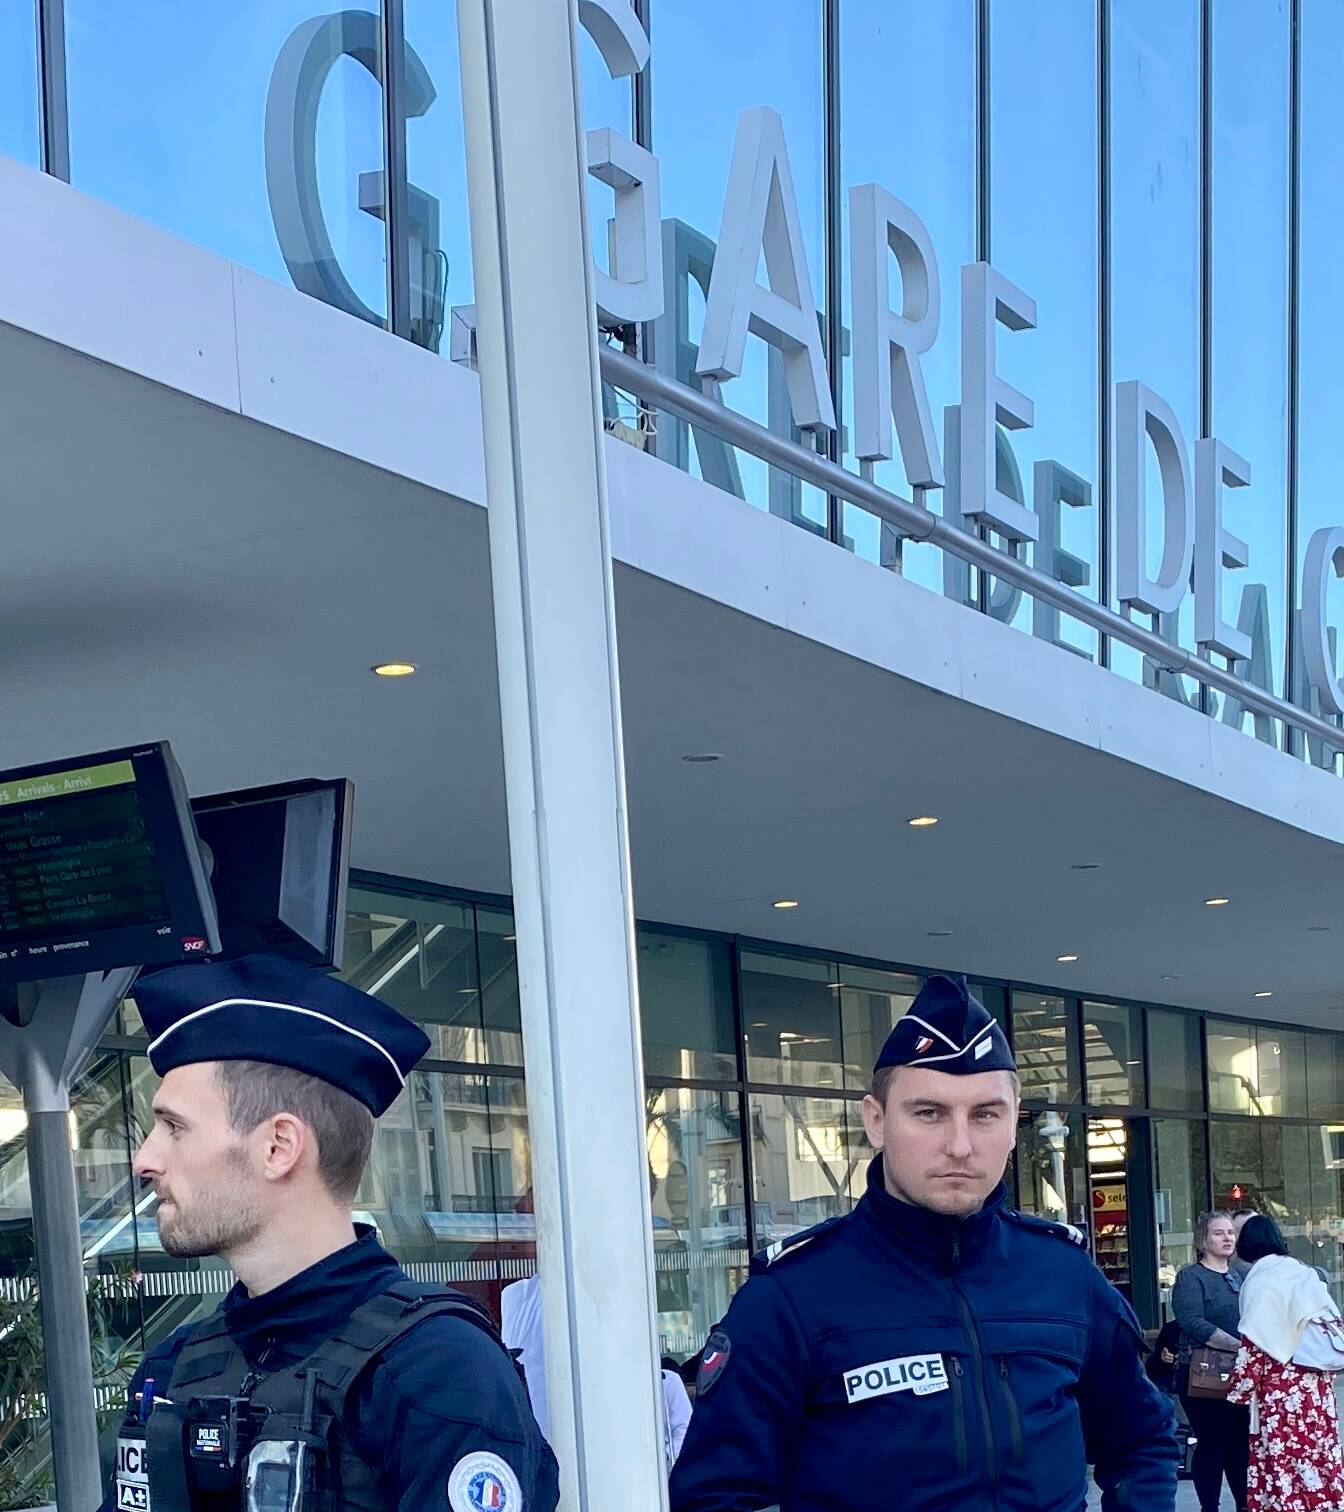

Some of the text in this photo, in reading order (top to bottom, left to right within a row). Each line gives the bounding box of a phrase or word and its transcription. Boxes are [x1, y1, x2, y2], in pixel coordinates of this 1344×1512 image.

[1116, 379, 1251, 661] DE
[17, 781, 55, 798] Arrivals
[63, 774, 92, 790] Arrivi
[847, 1360, 944, 1396] POLICE
[198, 1428, 219, 1440] POLICE
[118, 1447, 147, 1473] ICE
